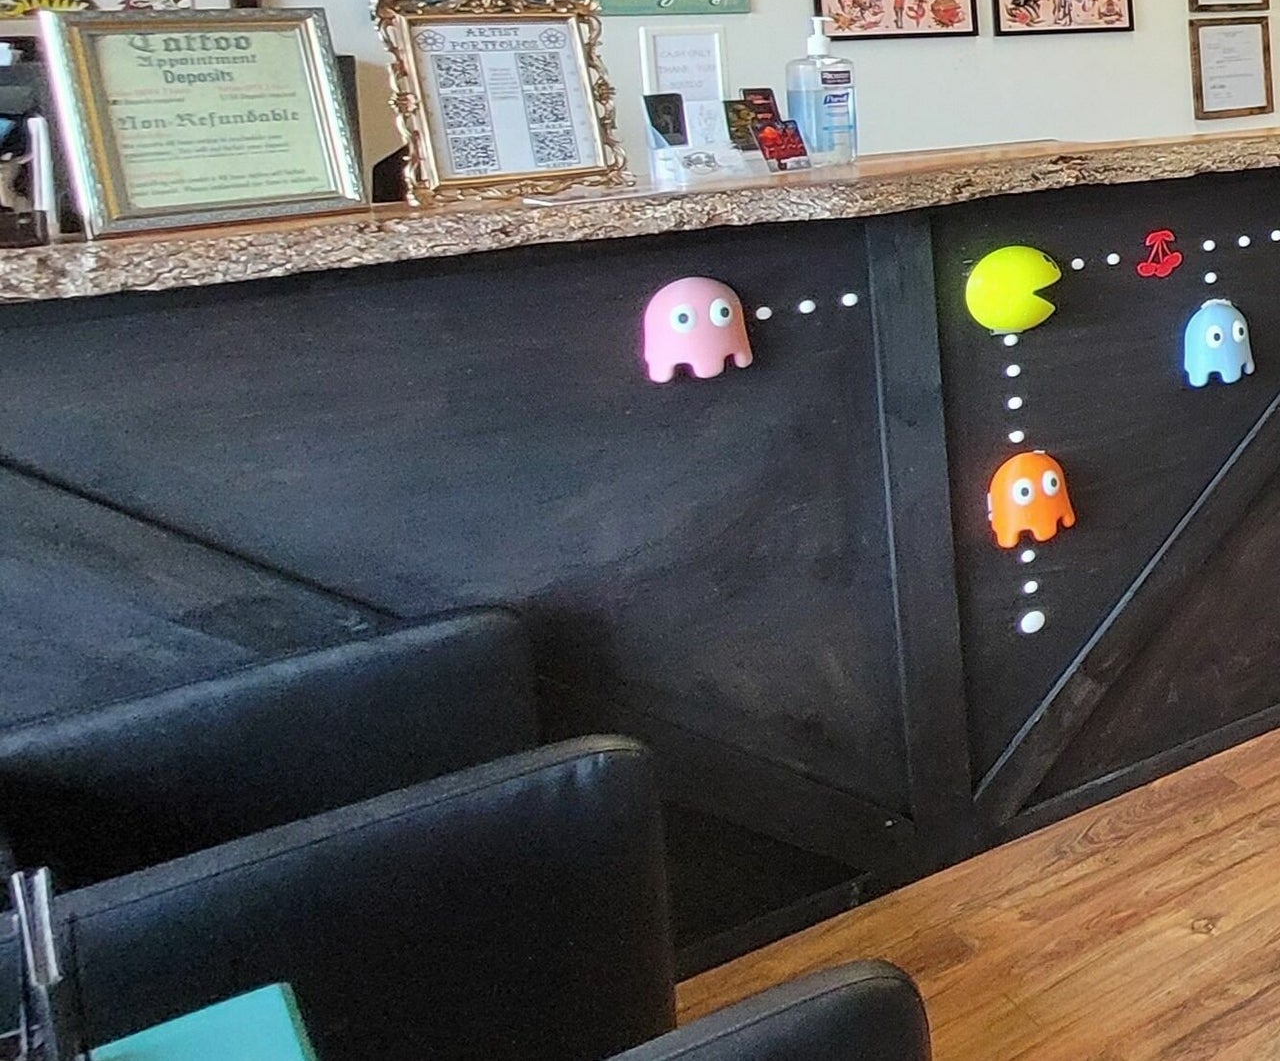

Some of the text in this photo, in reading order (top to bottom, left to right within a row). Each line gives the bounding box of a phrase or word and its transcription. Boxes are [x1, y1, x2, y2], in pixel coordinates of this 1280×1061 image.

[465, 27, 521, 38] ARTIST
[449, 40, 540, 51] PORTFOLIOS
[136, 53, 258, 69] Appointment
[162, 69, 235, 86] Deposits
